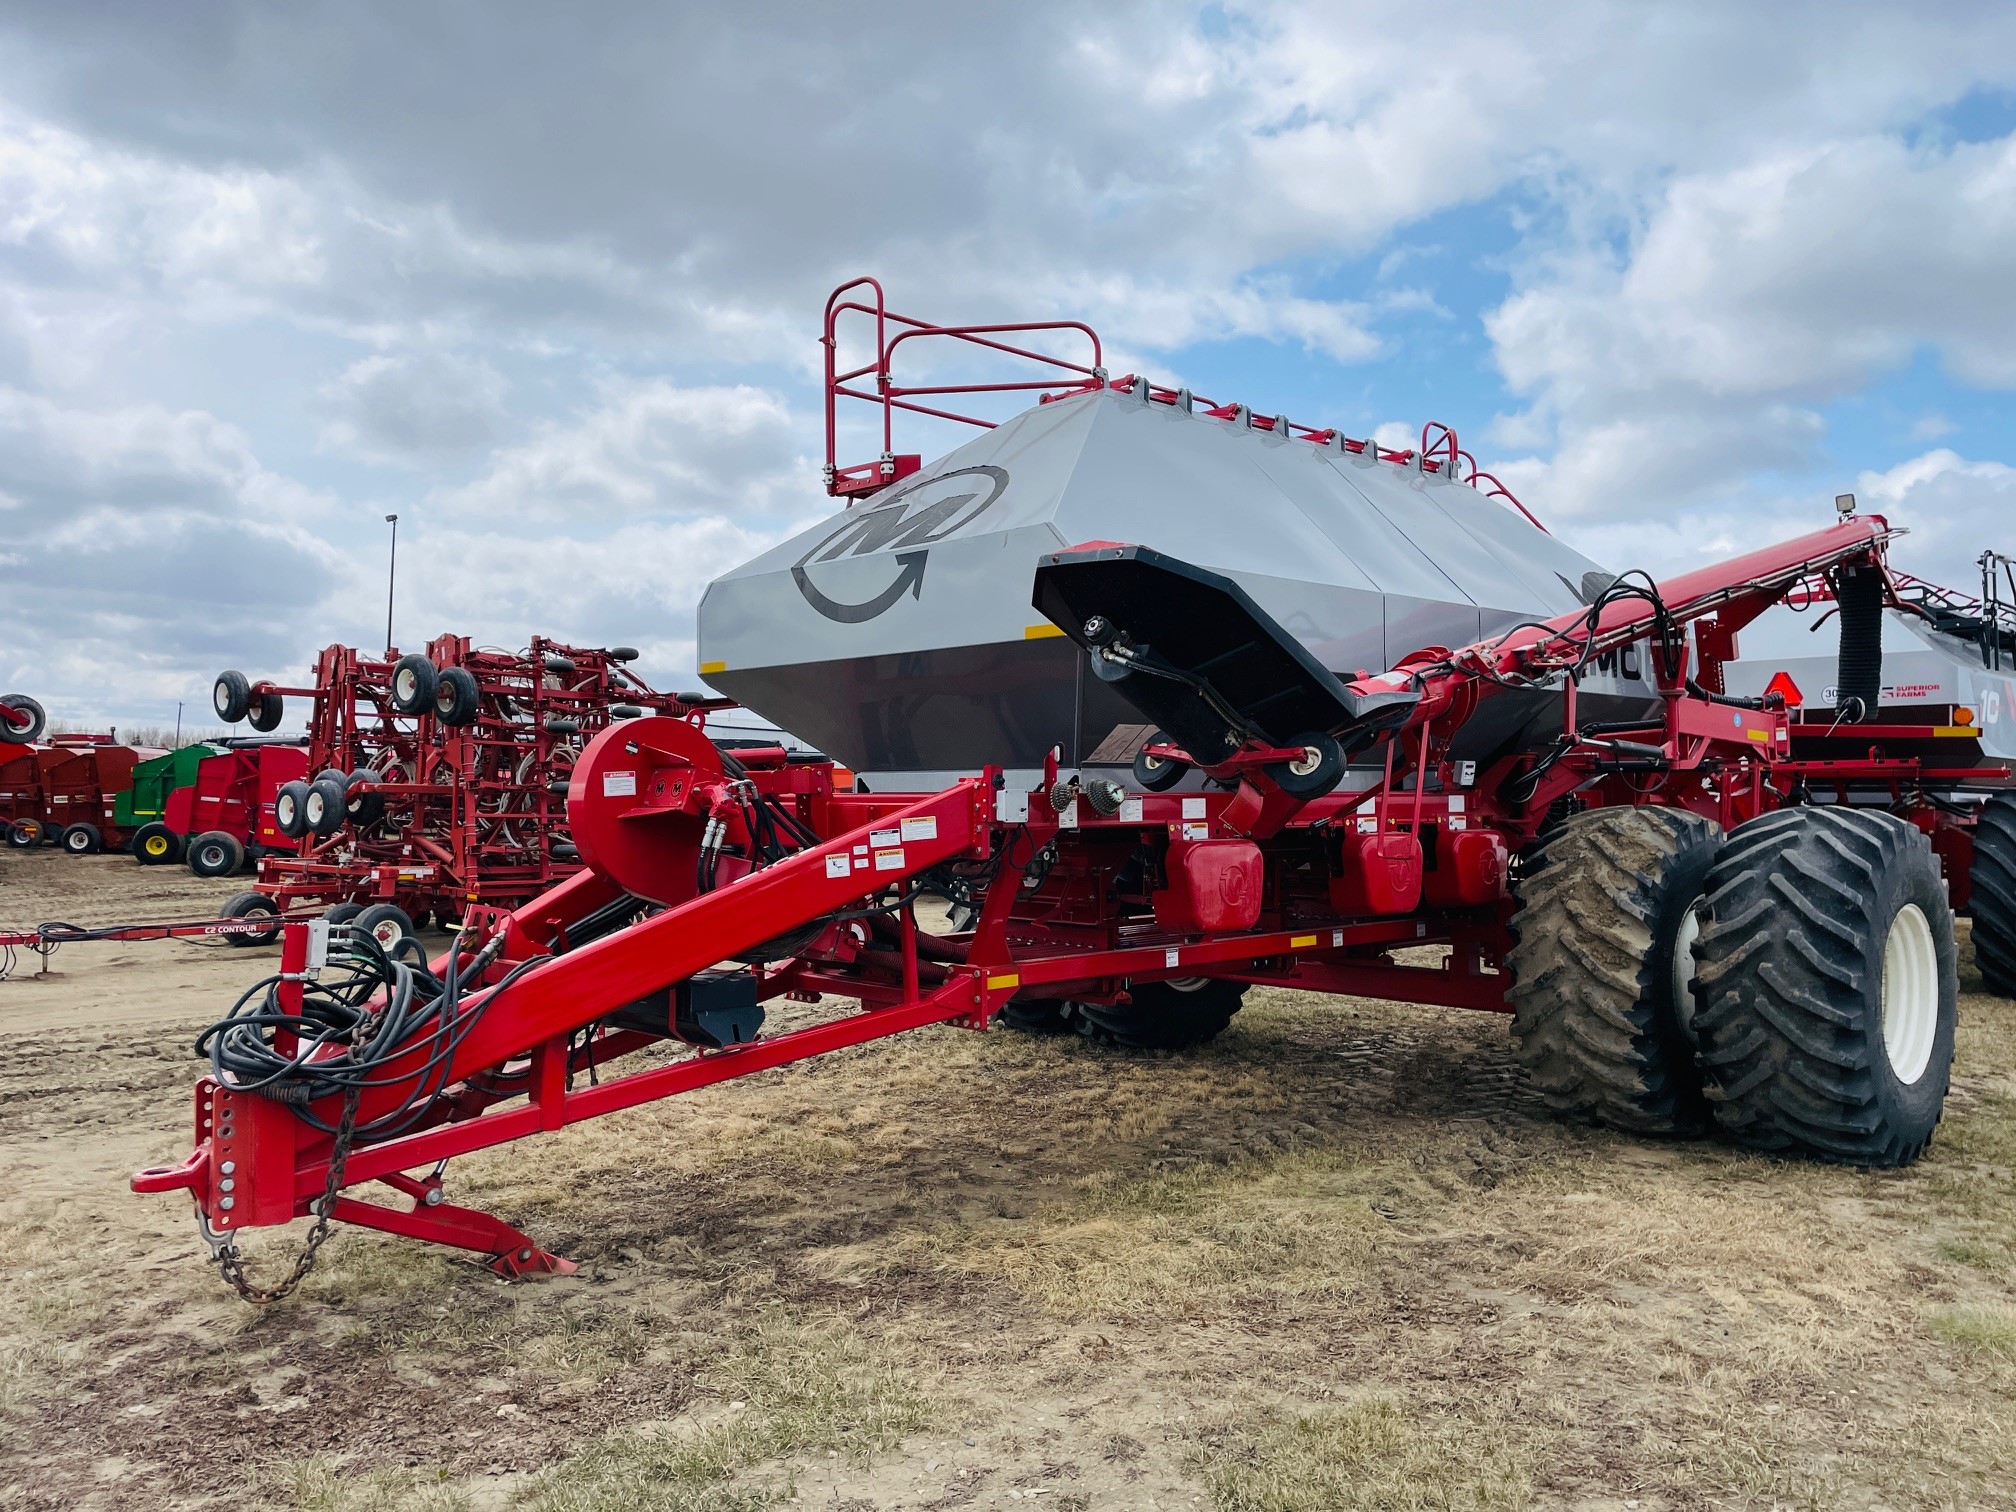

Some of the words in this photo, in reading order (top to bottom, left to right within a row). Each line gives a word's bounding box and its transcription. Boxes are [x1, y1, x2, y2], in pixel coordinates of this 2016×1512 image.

[1896, 684, 1940, 692] SUPERIOR
[205, 926, 216, 934] C2
[217, 925, 257, 934] CONTOUR
